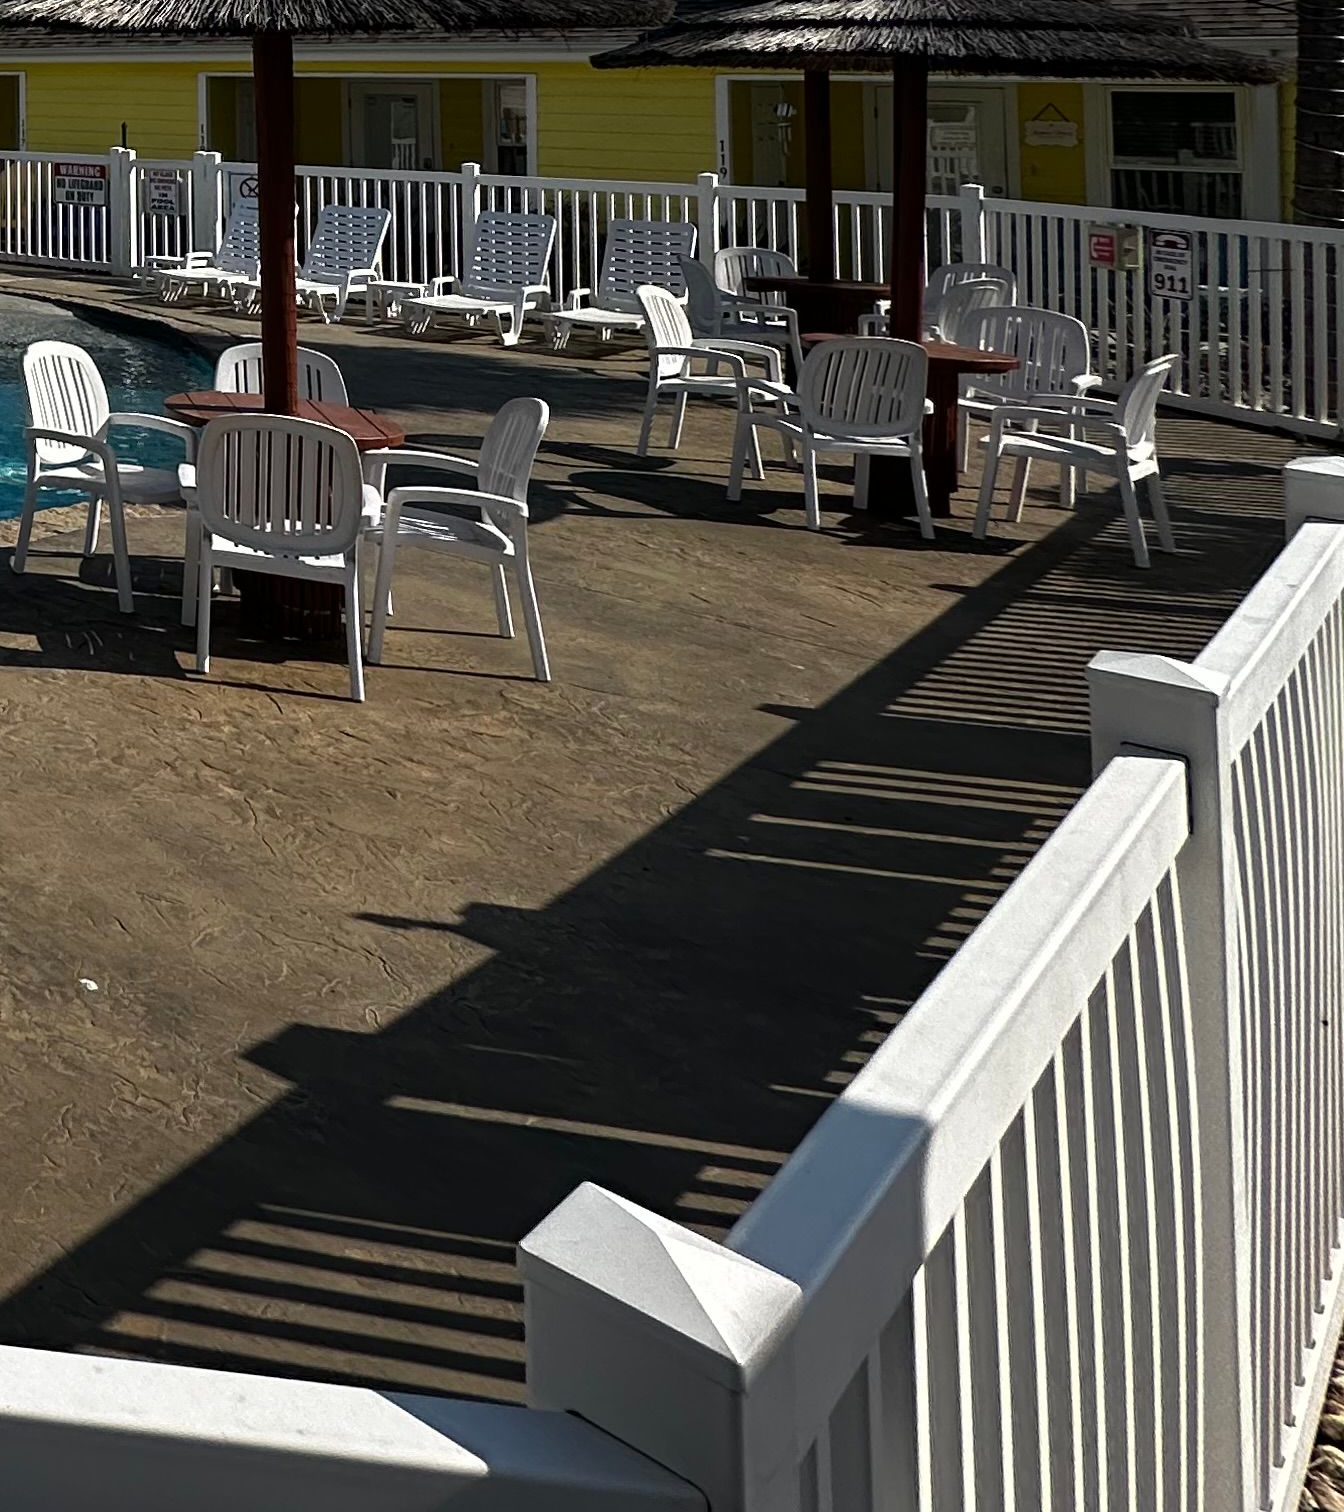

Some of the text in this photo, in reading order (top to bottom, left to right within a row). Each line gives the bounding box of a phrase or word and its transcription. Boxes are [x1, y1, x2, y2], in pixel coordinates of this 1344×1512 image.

[719, 139, 728, 179] 119
[59, 164, 101, 177] WARNING
[57, 178, 103, 191] NO LIFEGUARD
[65, 191, 94, 202] ON DUTY
[1154, 273, 1189, 293] 911
